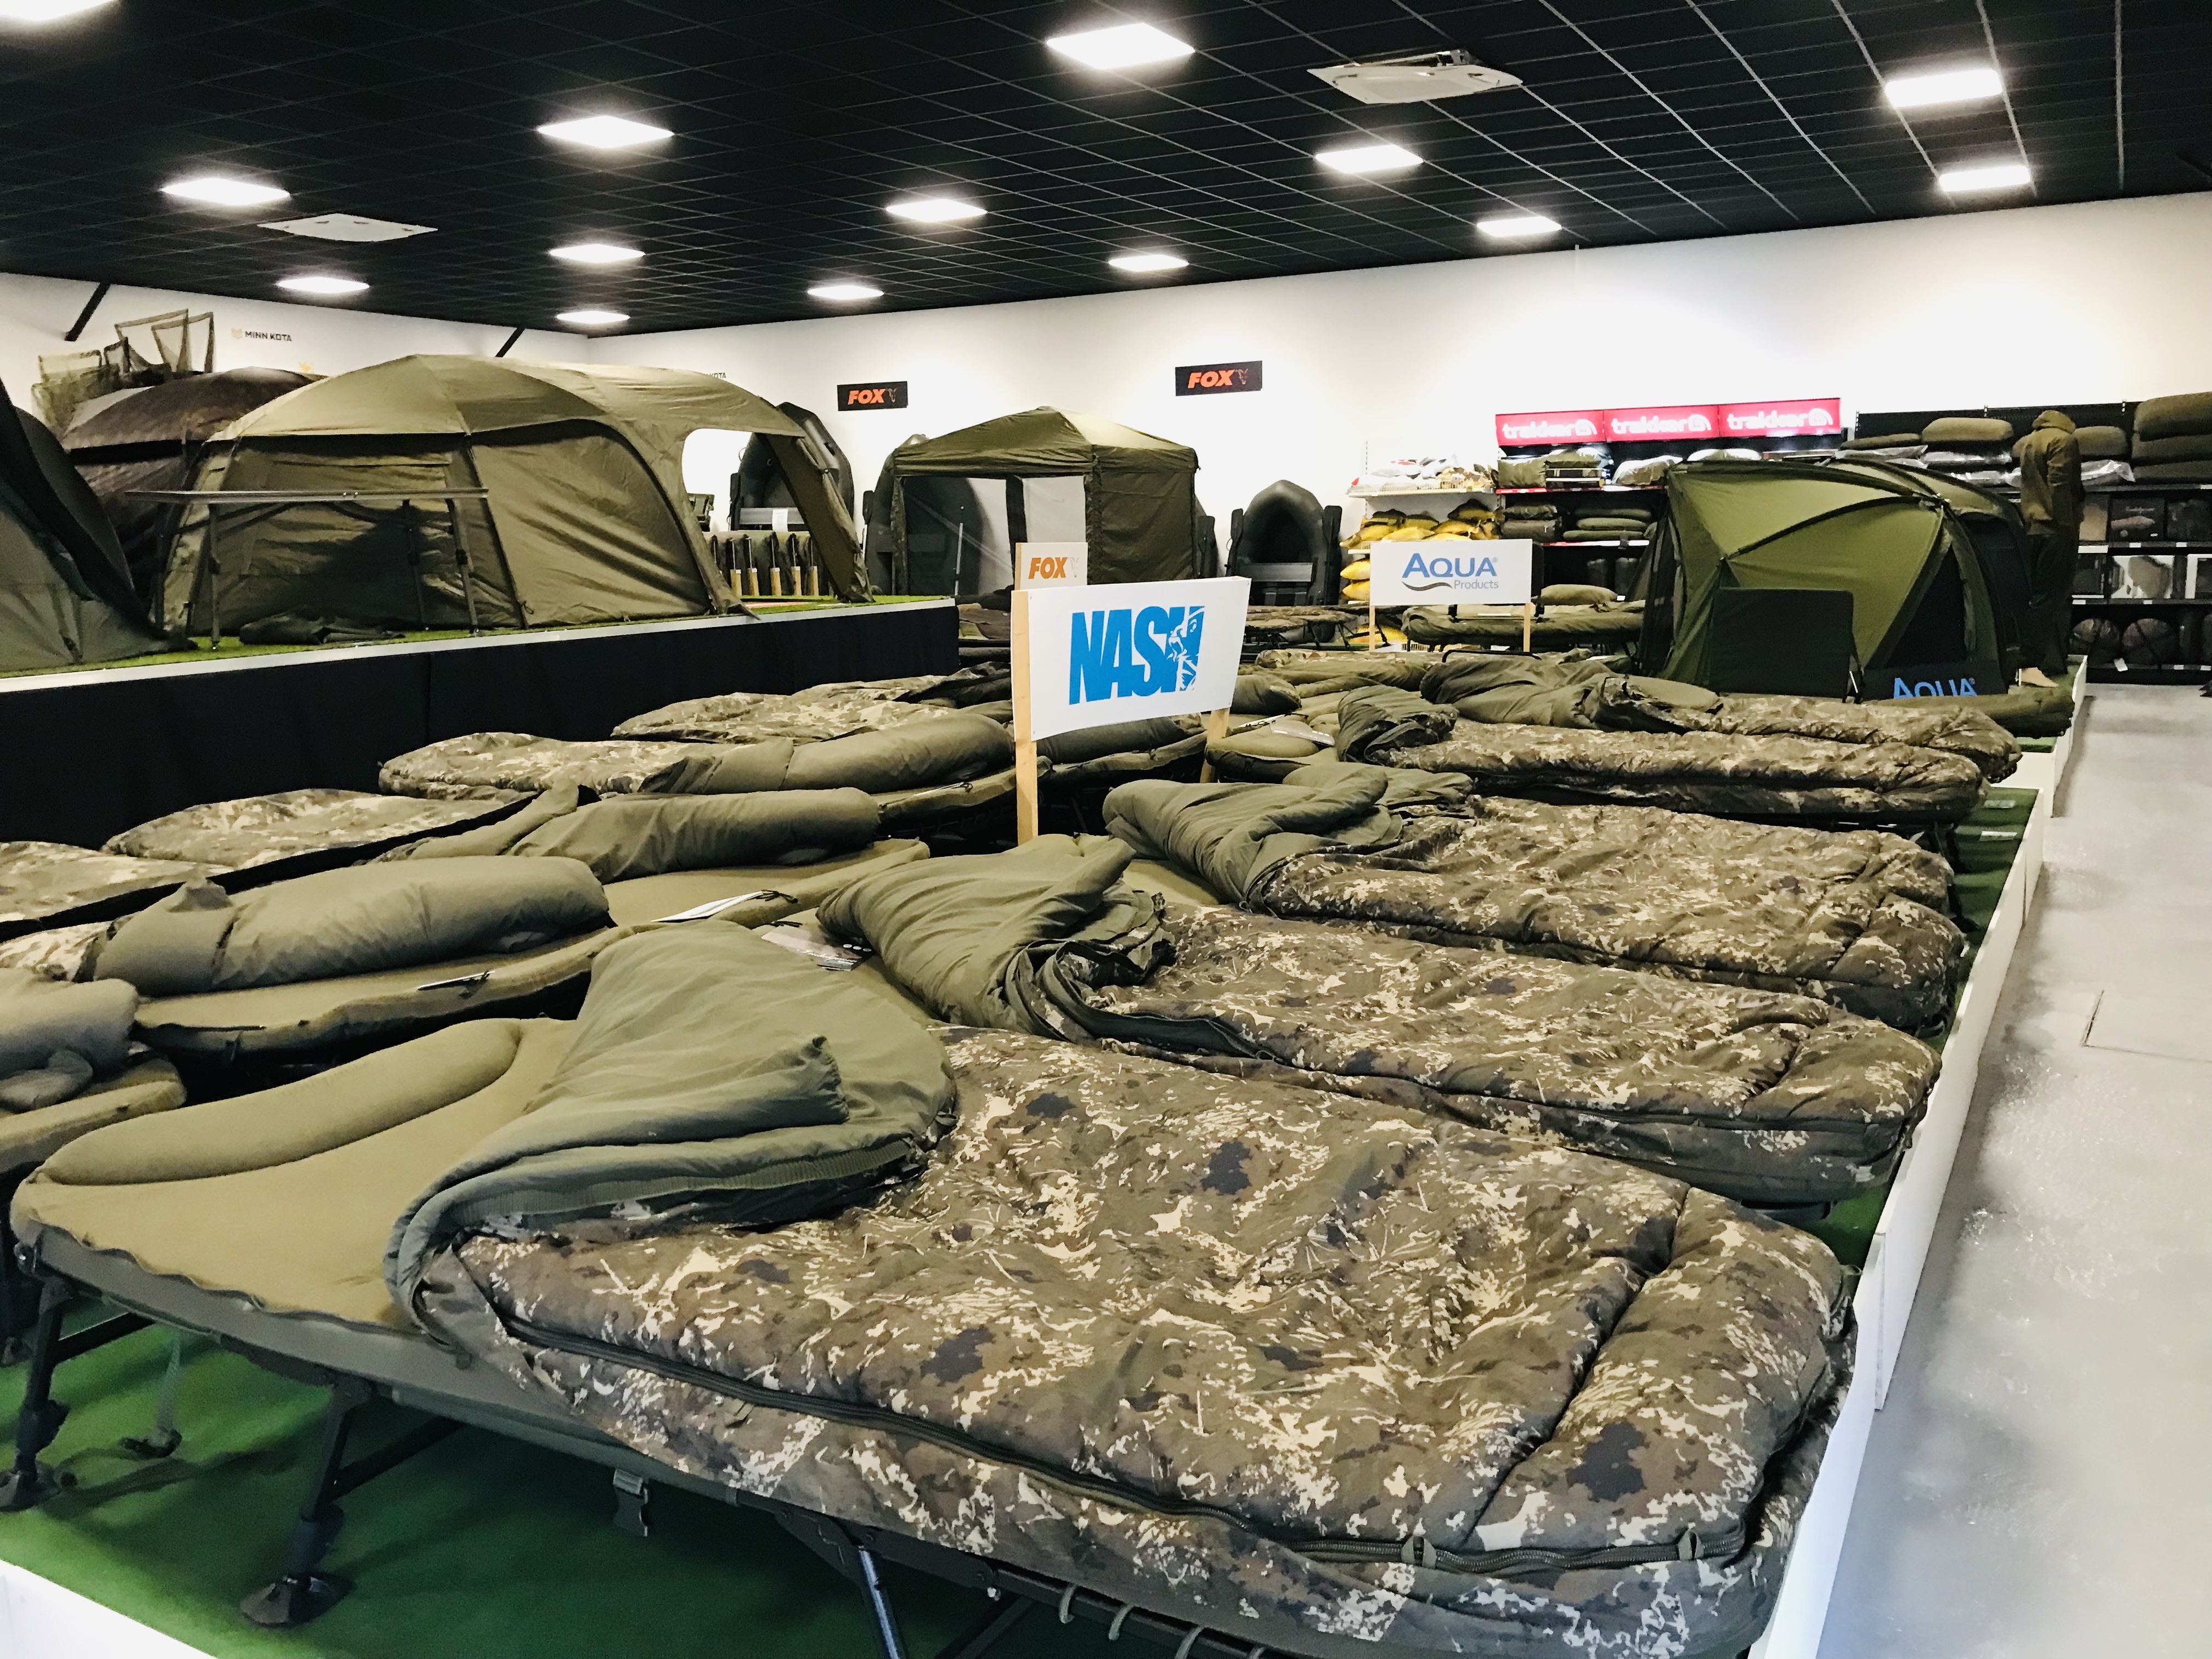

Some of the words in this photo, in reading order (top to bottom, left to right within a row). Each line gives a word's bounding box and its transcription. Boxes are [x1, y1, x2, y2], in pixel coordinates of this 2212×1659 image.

[245, 331, 268, 340] MINN
[270, 333, 292, 342] KOTA
[1187, 369, 1235, 389] FOX
[848, 388, 886, 405] FOX
[1502, 420, 1576, 439] trakker
[1611, 415, 1688, 435] trakker
[1726, 410, 1809, 430] trakker
[1028, 557, 1067, 579] FOX
[1402, 552, 1498, 578] AQUA
[1454, 579, 1499, 590] Products
[1069, 605, 1205, 706] NASH
